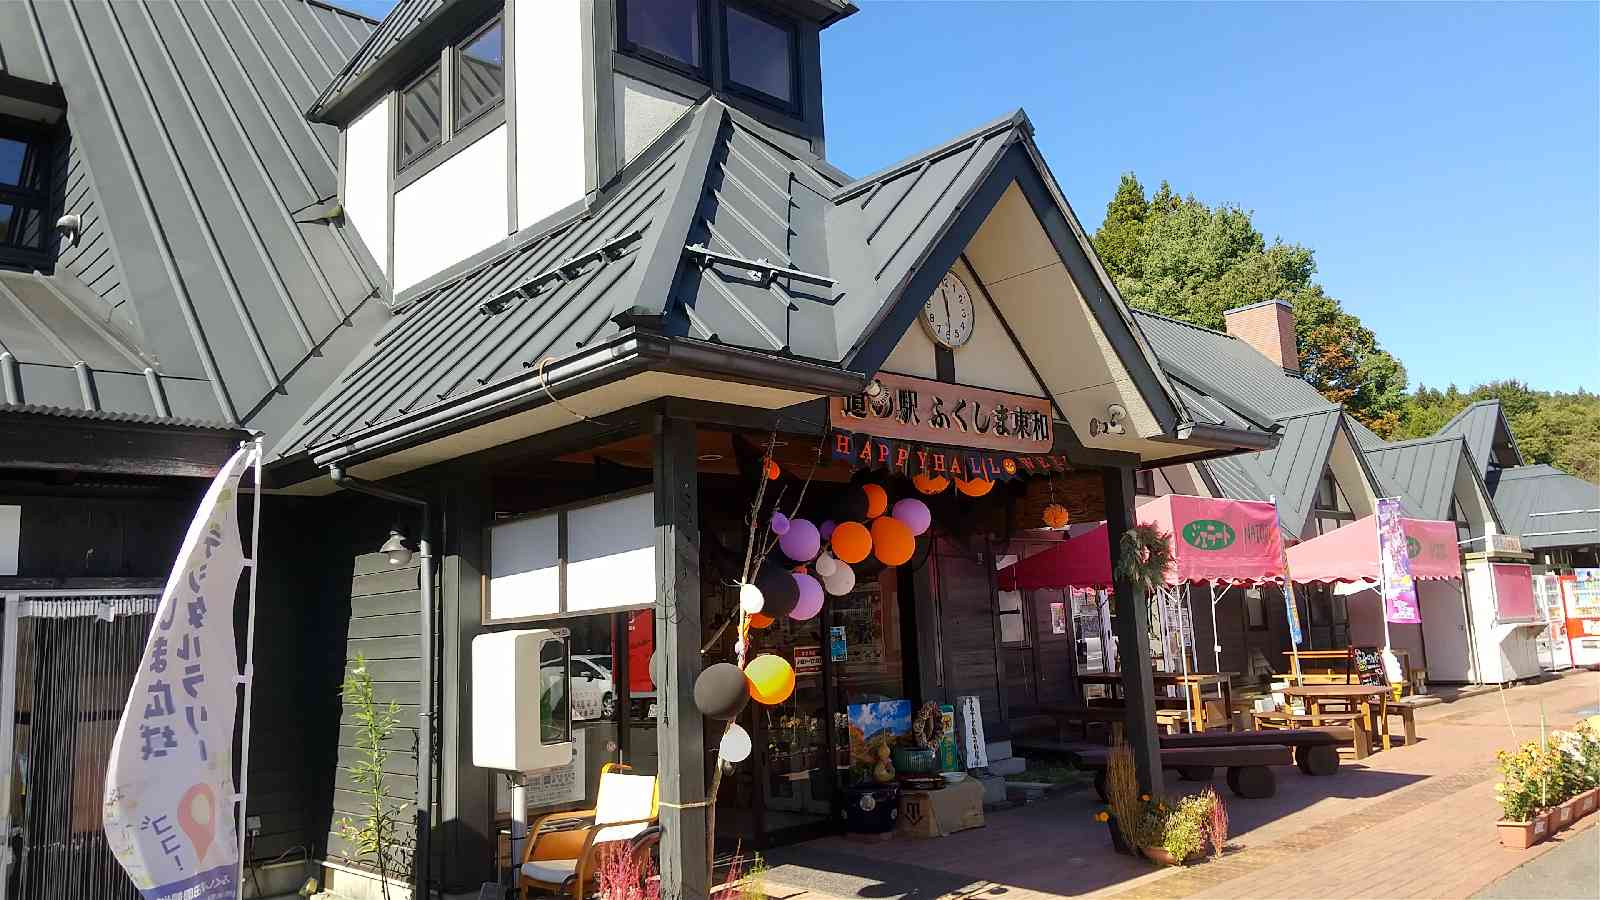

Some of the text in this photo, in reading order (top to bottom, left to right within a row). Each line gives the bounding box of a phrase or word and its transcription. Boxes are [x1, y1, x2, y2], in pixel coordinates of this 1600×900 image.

[928, 395, 1050, 441] ふくしま東和
